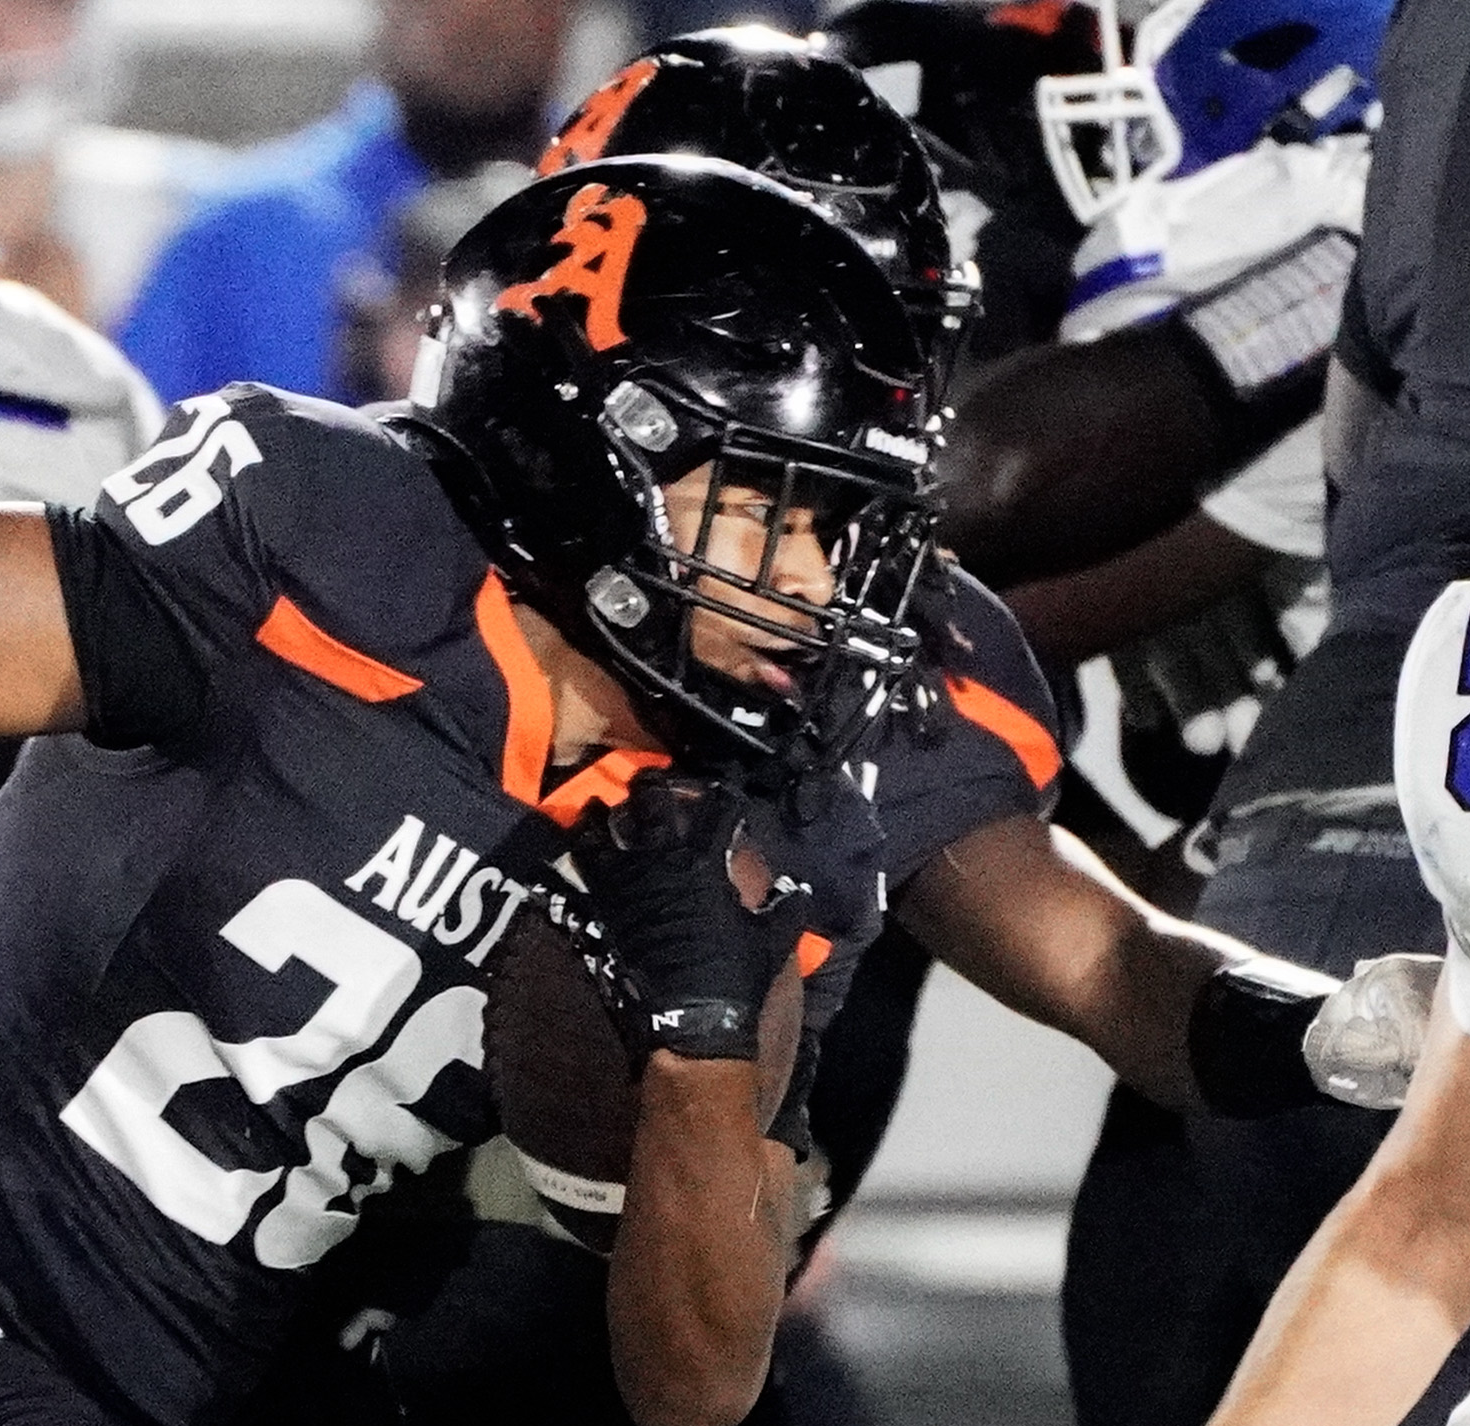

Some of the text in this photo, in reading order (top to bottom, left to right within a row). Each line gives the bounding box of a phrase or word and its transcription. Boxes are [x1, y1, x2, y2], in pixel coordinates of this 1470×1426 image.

[100, 395, 264, 547] 26
[342, 813, 532, 968] AUST
[58, 879, 488, 1270] 26
